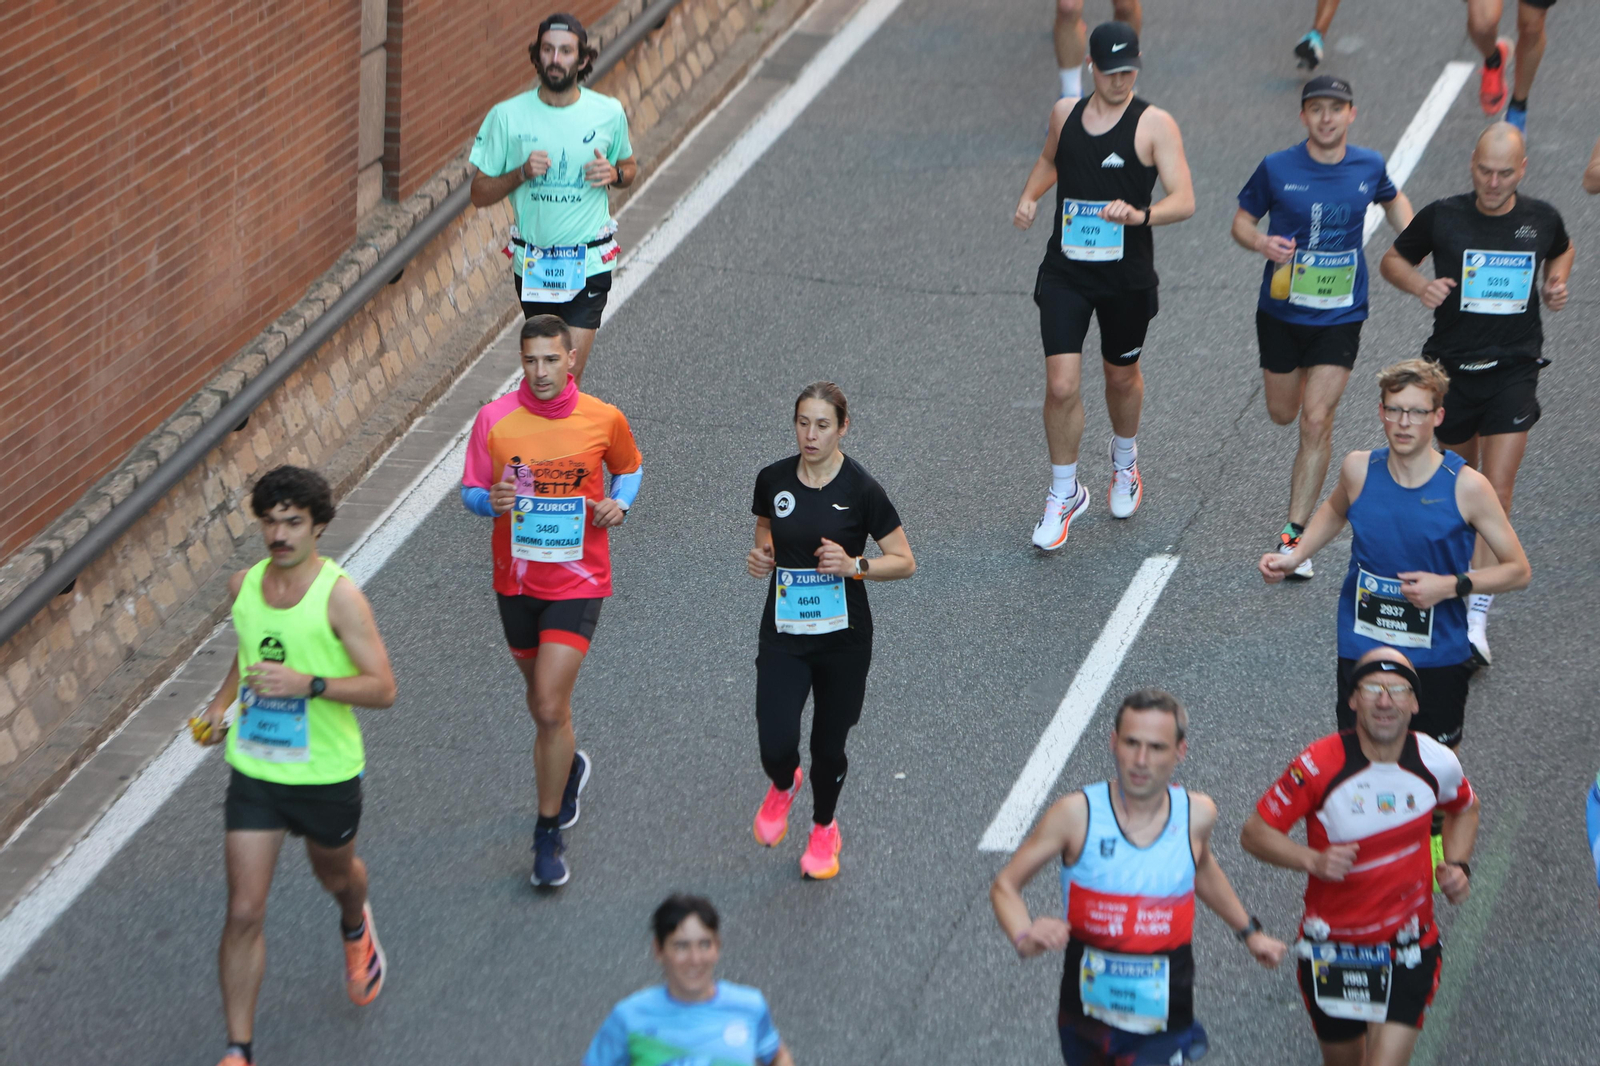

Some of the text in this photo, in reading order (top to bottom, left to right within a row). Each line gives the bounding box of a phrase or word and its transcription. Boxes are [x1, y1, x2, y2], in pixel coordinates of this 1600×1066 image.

[546, 249, 579, 258] ZURICH
[1318, 255, 1351, 267] ZURICH
[1488, 256, 1528, 267] ZURICH
[545, 268, 565, 277] 6128
[542, 281, 567, 289] XABIER
[1316, 275, 1337, 285] 1477
[1487, 276, 1510, 287] 5319
[533, 480, 570, 494] RETT
[536, 503, 576, 512] ZURICH
[535, 524, 559, 534] 3480
[516, 536, 580, 547] GNOMO GONZALO
[796, 574, 834, 584] ZURICH
[797, 596, 820, 606] 4640
[800, 610, 822, 619] NOUR
[1379, 603, 1405, 617] 2937
[1375, 616, 1408, 632] STEFAN
[1342, 986, 1371, 1003] LUCAS
